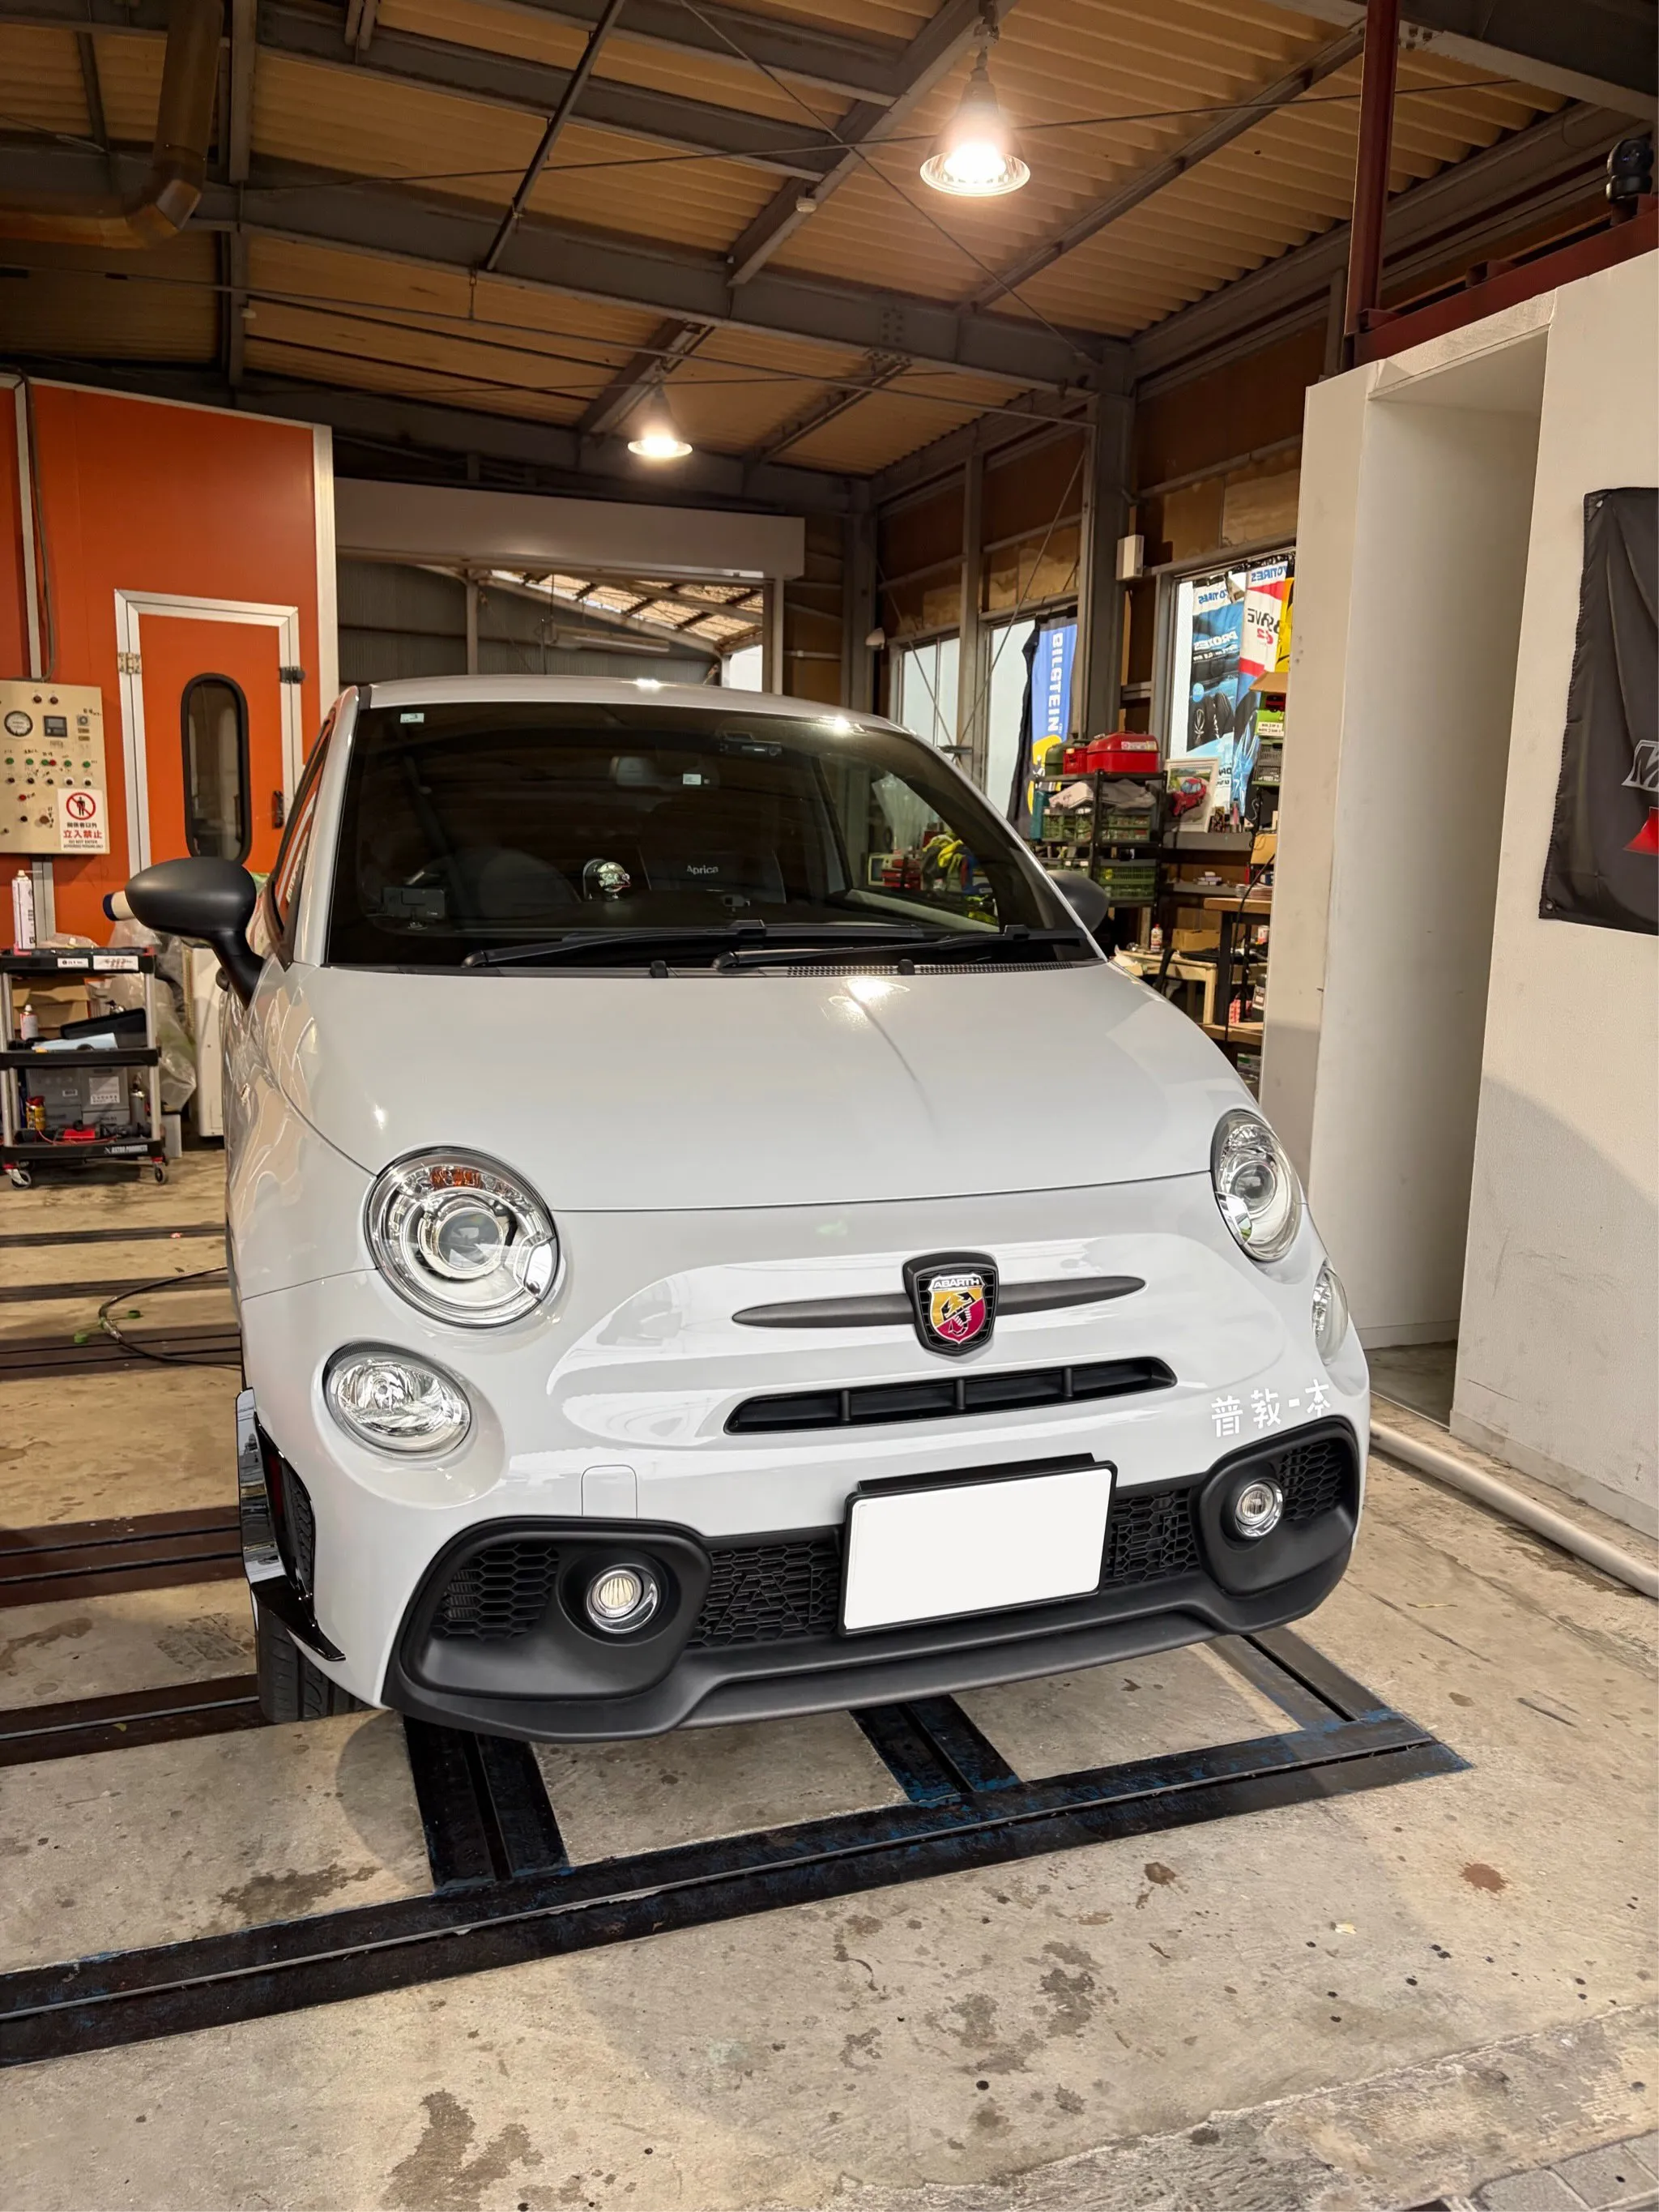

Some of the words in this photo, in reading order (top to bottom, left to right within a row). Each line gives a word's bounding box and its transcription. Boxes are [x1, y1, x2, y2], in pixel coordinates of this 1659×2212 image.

[1047, 632, 1063, 732] BILSTEIN
[63, 829, 103, 839] 立入禁止
[686, 865, 719, 875] Aprica
[933, 1279, 979, 1288] ABARTH
